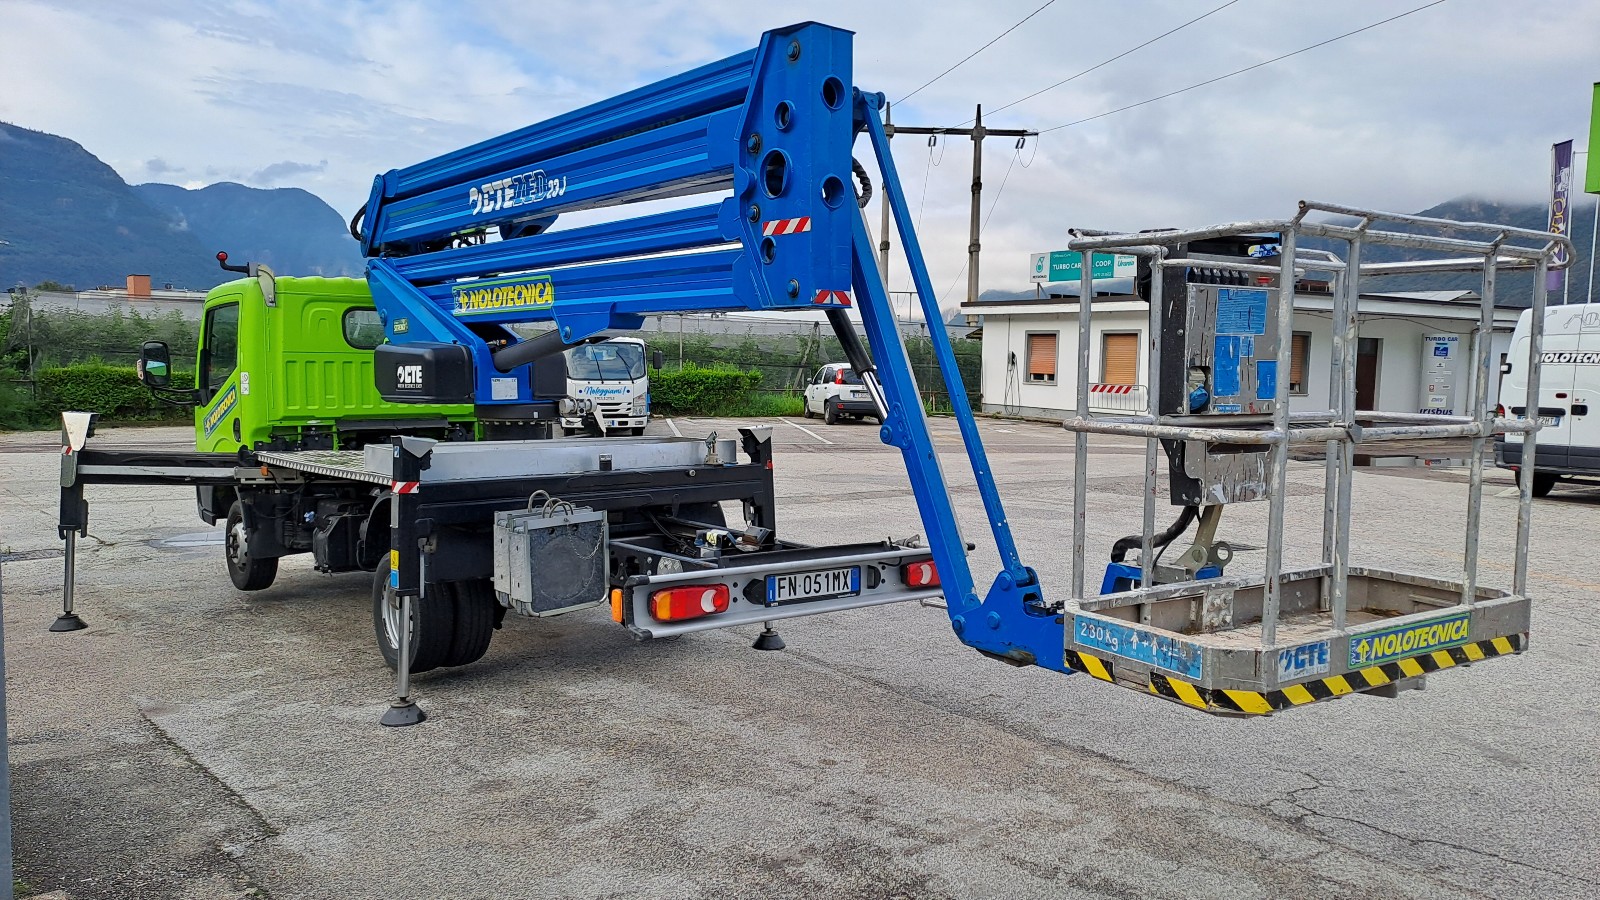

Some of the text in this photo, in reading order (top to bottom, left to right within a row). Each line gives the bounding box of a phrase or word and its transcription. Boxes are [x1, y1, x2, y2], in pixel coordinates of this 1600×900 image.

[469, 282, 552, 309] NOLOTECNICA
[778, 575, 797, 598] FN
[803, 570, 850, 595] 051MX
[1371, 618, 1470, 658] NOLOTECNICA
